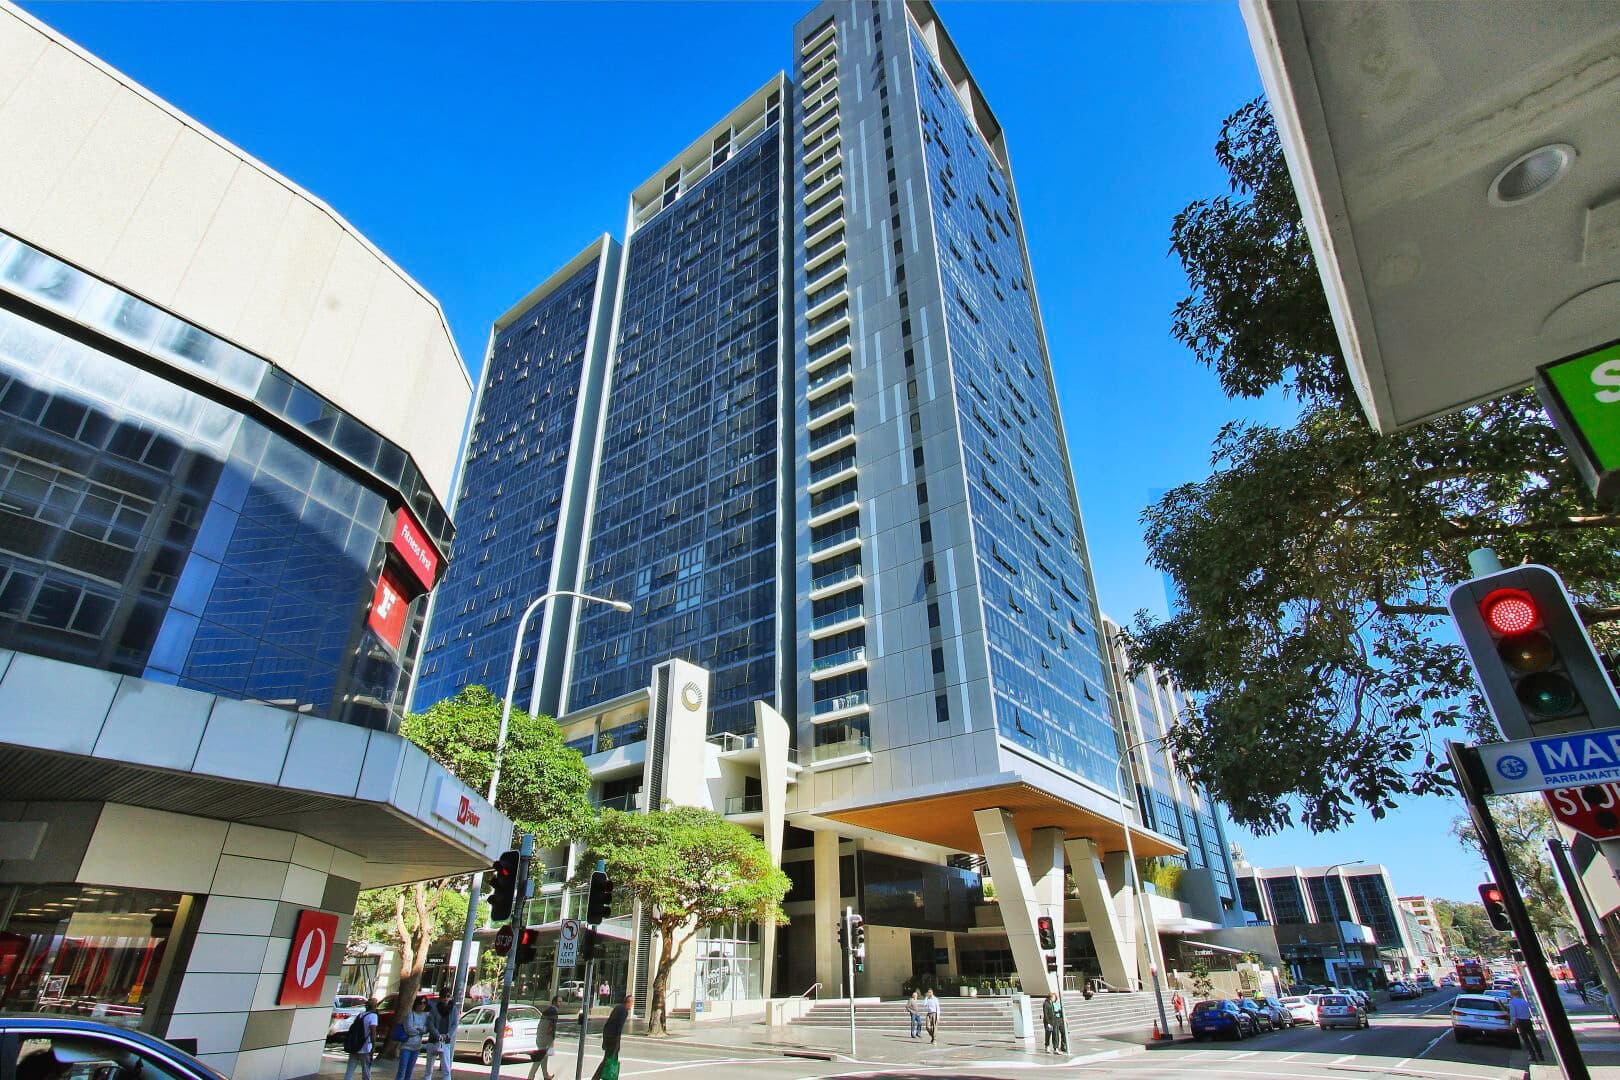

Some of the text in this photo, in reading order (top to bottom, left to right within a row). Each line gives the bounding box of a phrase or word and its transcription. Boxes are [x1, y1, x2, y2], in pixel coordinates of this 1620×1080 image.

[1590, 359, 1620, 403] S
[377, 585, 397, 620] F
[562, 942, 574, 950] NO
